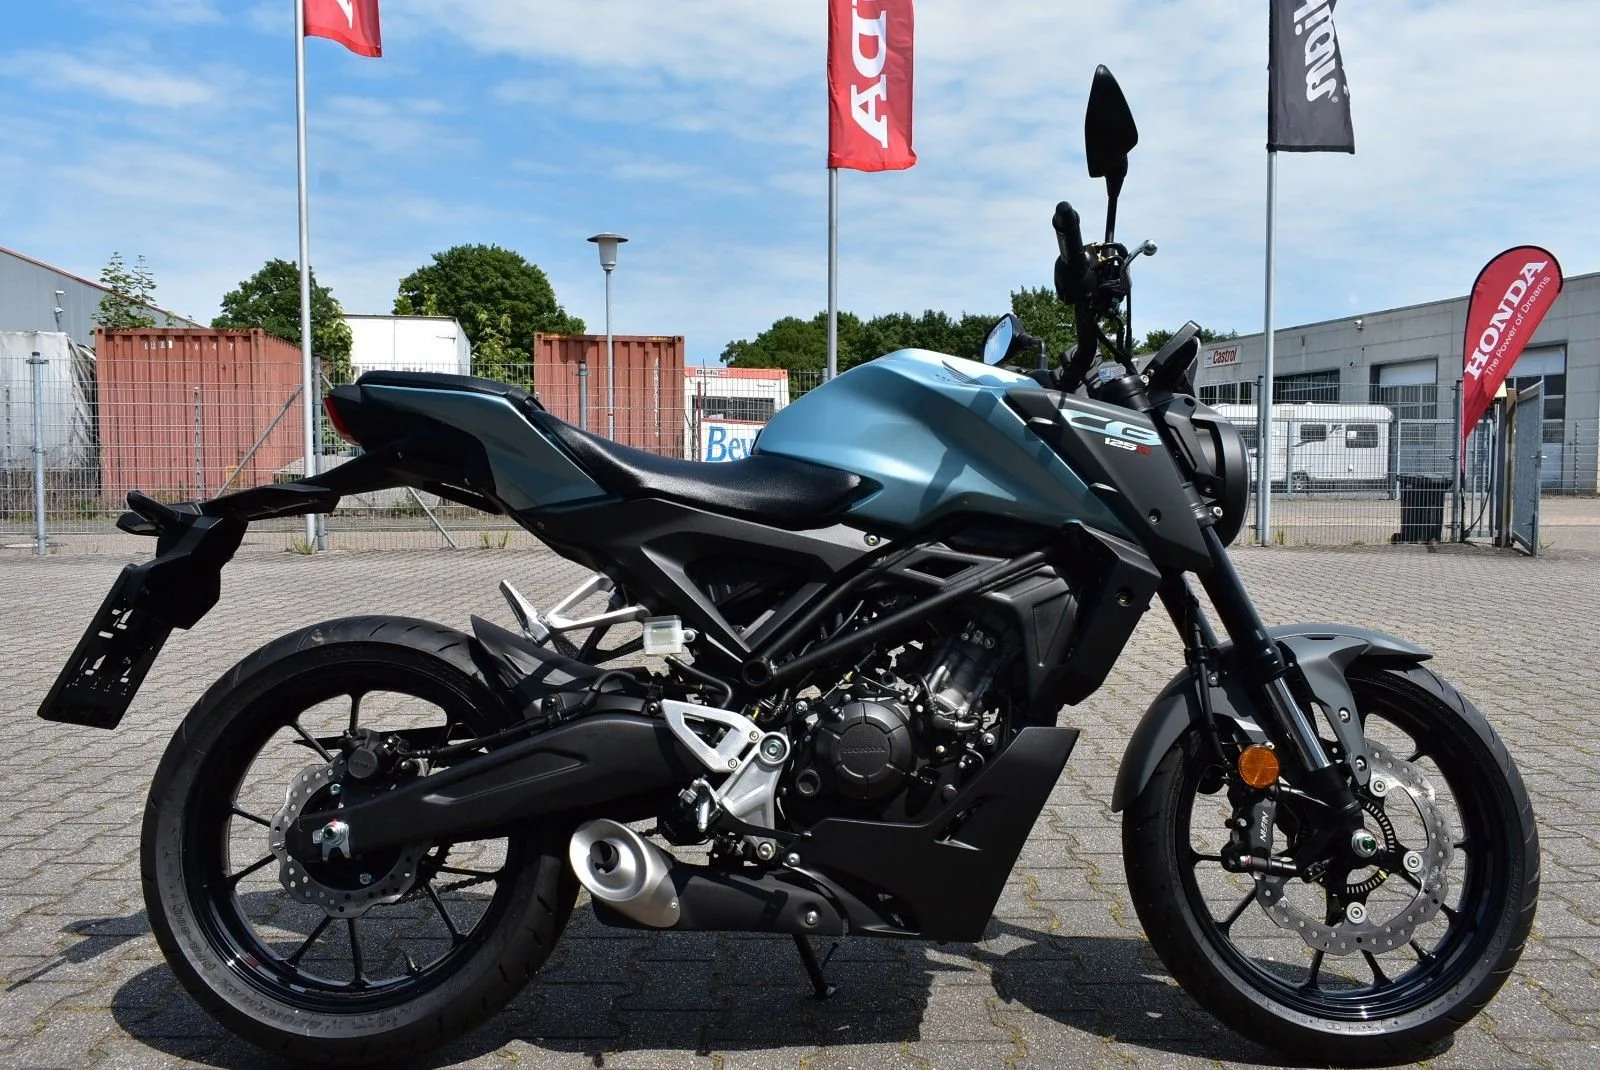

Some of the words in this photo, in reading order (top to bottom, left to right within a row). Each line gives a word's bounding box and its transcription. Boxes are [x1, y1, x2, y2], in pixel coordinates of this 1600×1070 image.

[1464, 260, 1548, 381] HONDA
[1484, 359, 1500, 376] The
[1495, 325, 1518, 358] Power
[1515, 312, 1525, 326] of
[1521, 275, 1551, 313] Dreams
[1212, 347, 1238, 364] Castrol
[705, 425, 763, 462] Bev
